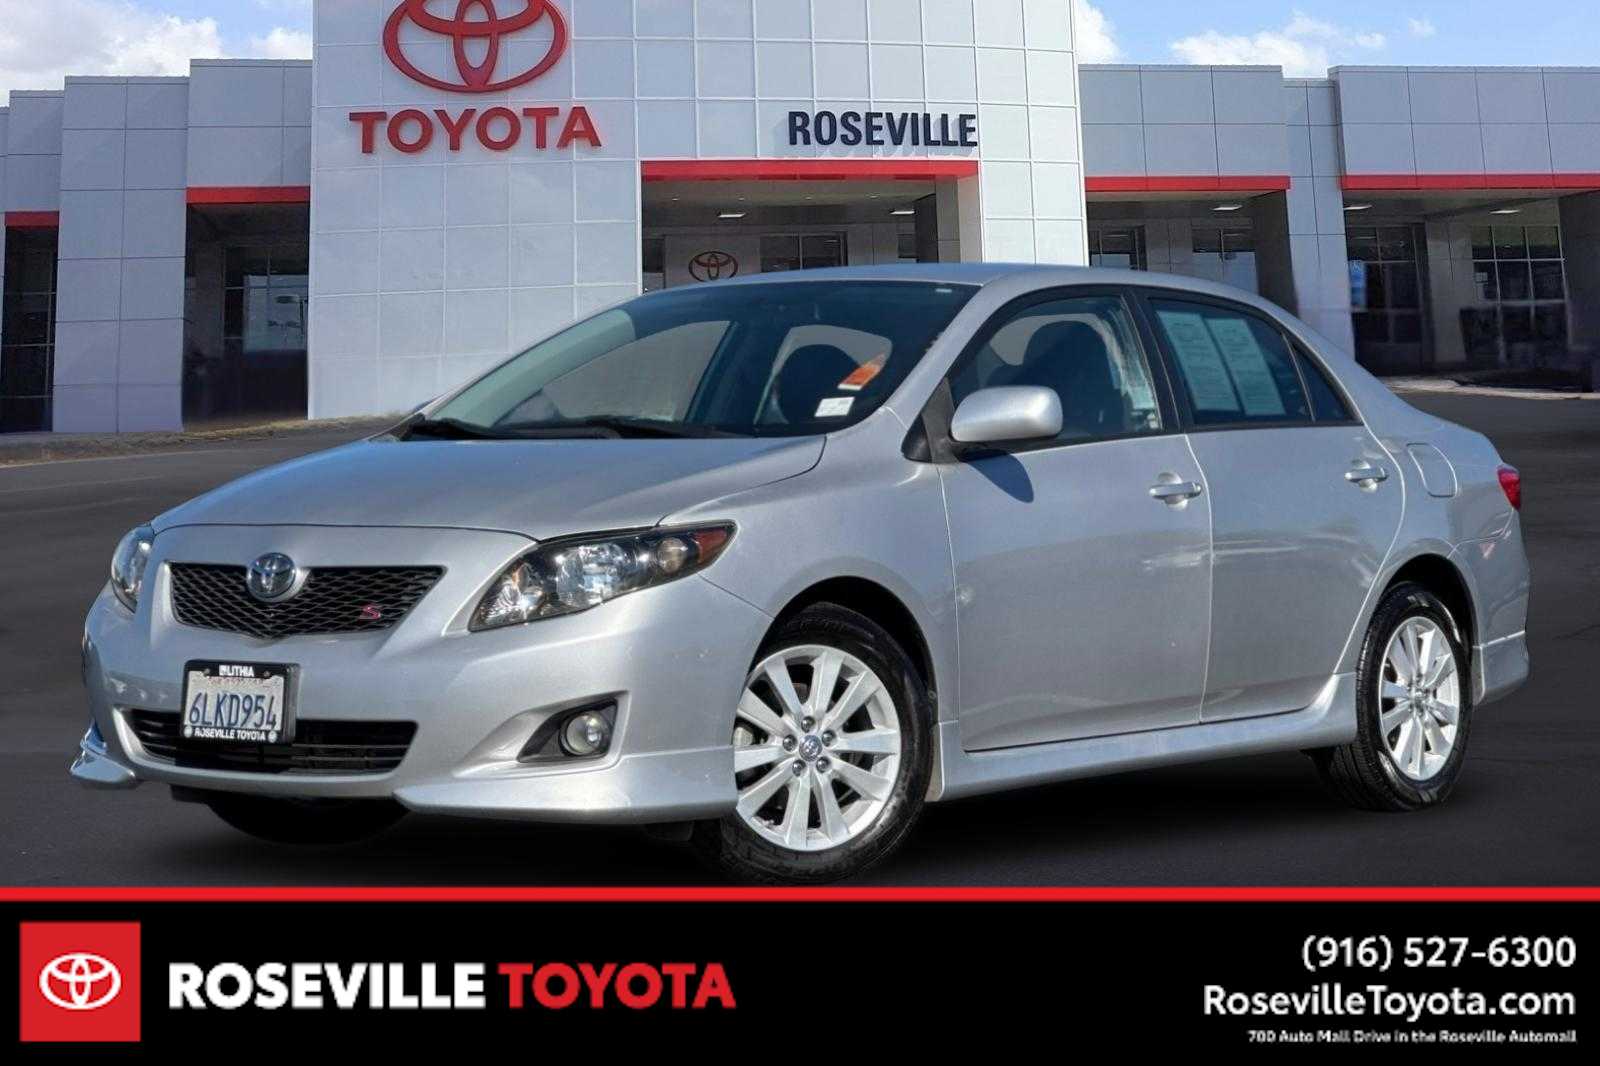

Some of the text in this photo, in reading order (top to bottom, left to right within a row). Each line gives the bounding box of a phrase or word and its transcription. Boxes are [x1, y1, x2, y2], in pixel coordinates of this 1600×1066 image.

[349, 106, 603, 154] TOYOTA
[788, 110, 979, 148] ROSEVILLE
[226, 664, 255, 677] LITHIA
[189, 691, 277, 730] 6LKD954
[194, 727, 266, 742] ROSEVILLE TOYOTA
